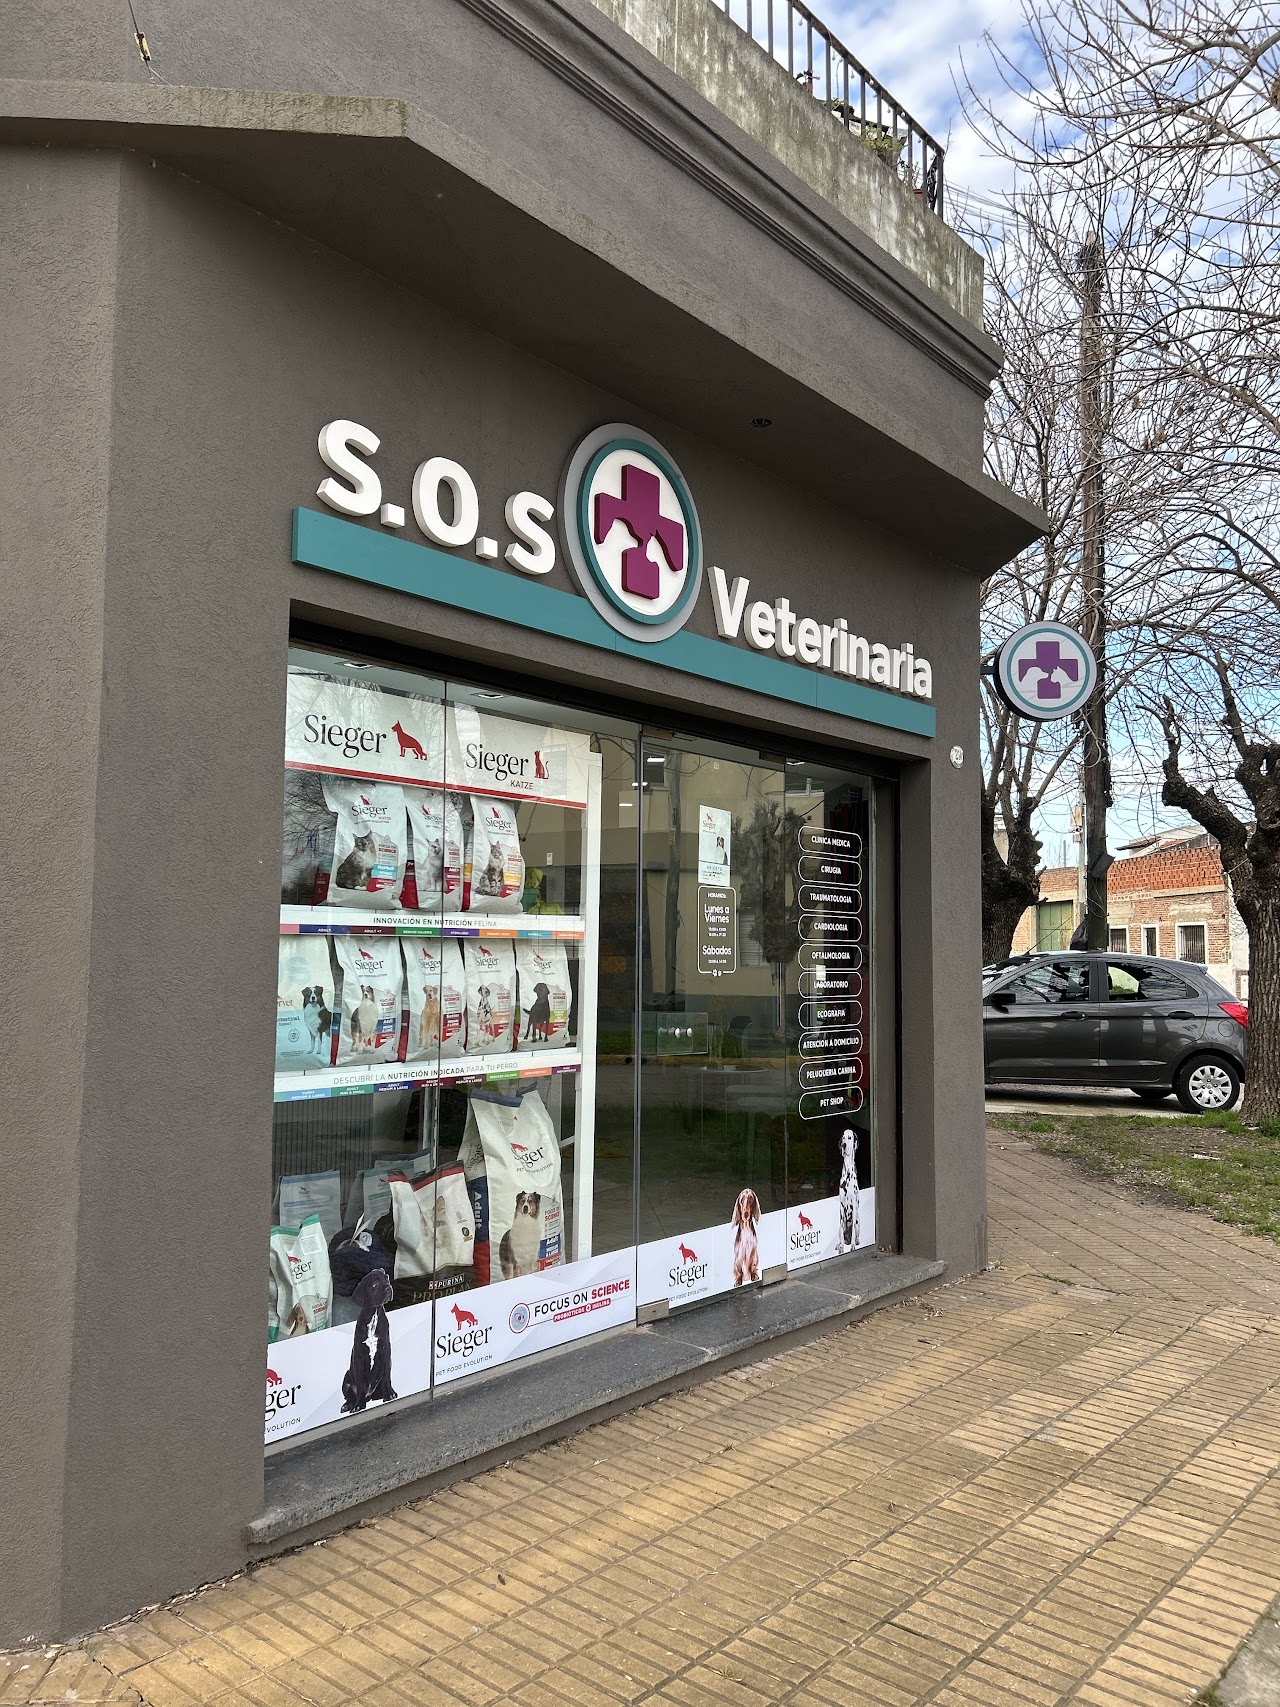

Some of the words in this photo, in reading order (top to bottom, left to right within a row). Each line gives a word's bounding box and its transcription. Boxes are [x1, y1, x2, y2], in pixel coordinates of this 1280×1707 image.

[707, 566, 933, 699] Veterinaria
[304, 714, 387, 758] Sieger
[466, 743, 529, 781] Sieger
[510, 779, 534, 791] KATZE
[351, 804, 388, 818] Sieger
[485, 816, 512, 830] Sieger
[811, 835, 832, 846] CLINICA
[831, 837, 851, 848] MEDICA
[820, 865, 842, 875] CIRUGIA
[809, 892, 853, 904] TRAUMATOLOGIA
[704, 903, 724, 914] Lunes
[724, 906, 730, 914] a
[373, 917, 419, 925] INNOVACIÓN
[434, 919, 472, 927] NUTRICIÓN
[474, 920, 498, 928] FELINA
[704, 912, 730, 924] Viernes
[813, 922, 849, 932] CARDIOLOGIA
[702, 944, 732, 956] Sábados
[811, 951, 851, 960] OFTALMOLOGIA
[354, 959, 385, 974] Sieger
[475, 957, 499, 969] Sieger
[813, 980, 849, 989] LABORATORIO
[817, 1009, 846, 1019] ECOGRAFIA
[803, 1039, 829, 1050] ATENCION
[829, 1039, 834, 1047] A
[834, 1036, 860, 1047] DOMICILIO
[333, 1074, 373, 1085] DESCUBRÍ
[388, 1070, 429, 1080] NUTRICIÓN
[430, 1067, 465, 1077] INDICADA
[466, 1065, 485, 1073] PARA
[497, 1062, 518, 1070] PERRO
[806, 1068, 838, 1079] PELUQUERIA
[837, 1065, 857, 1076] CANINA
[820, 1098, 830, 1108] PET
[830, 1096, 844, 1106] SHOP
[474, 1191, 483, 1229] Adult
[790, 1230, 821, 1252] Sieger
[437, 1275, 464, 1289] PURINA
[668, 1263, 708, 1288] Sieger
[534, 1297, 570, 1318] FOCUS
[573, 1291, 588, 1305] ON
[591, 1279, 630, 1300] SCIENCE
[554, 1308, 585, 1321] PROBIÓTICOS
[436, 1326, 493, 1359] Sieger
[436, 1369, 445, 1377] PET
[447, 1364, 462, 1373] FOOD
[463, 1354, 493, 1368] EVOLUTION
[265, 1417, 301, 1433] VOLUTION
